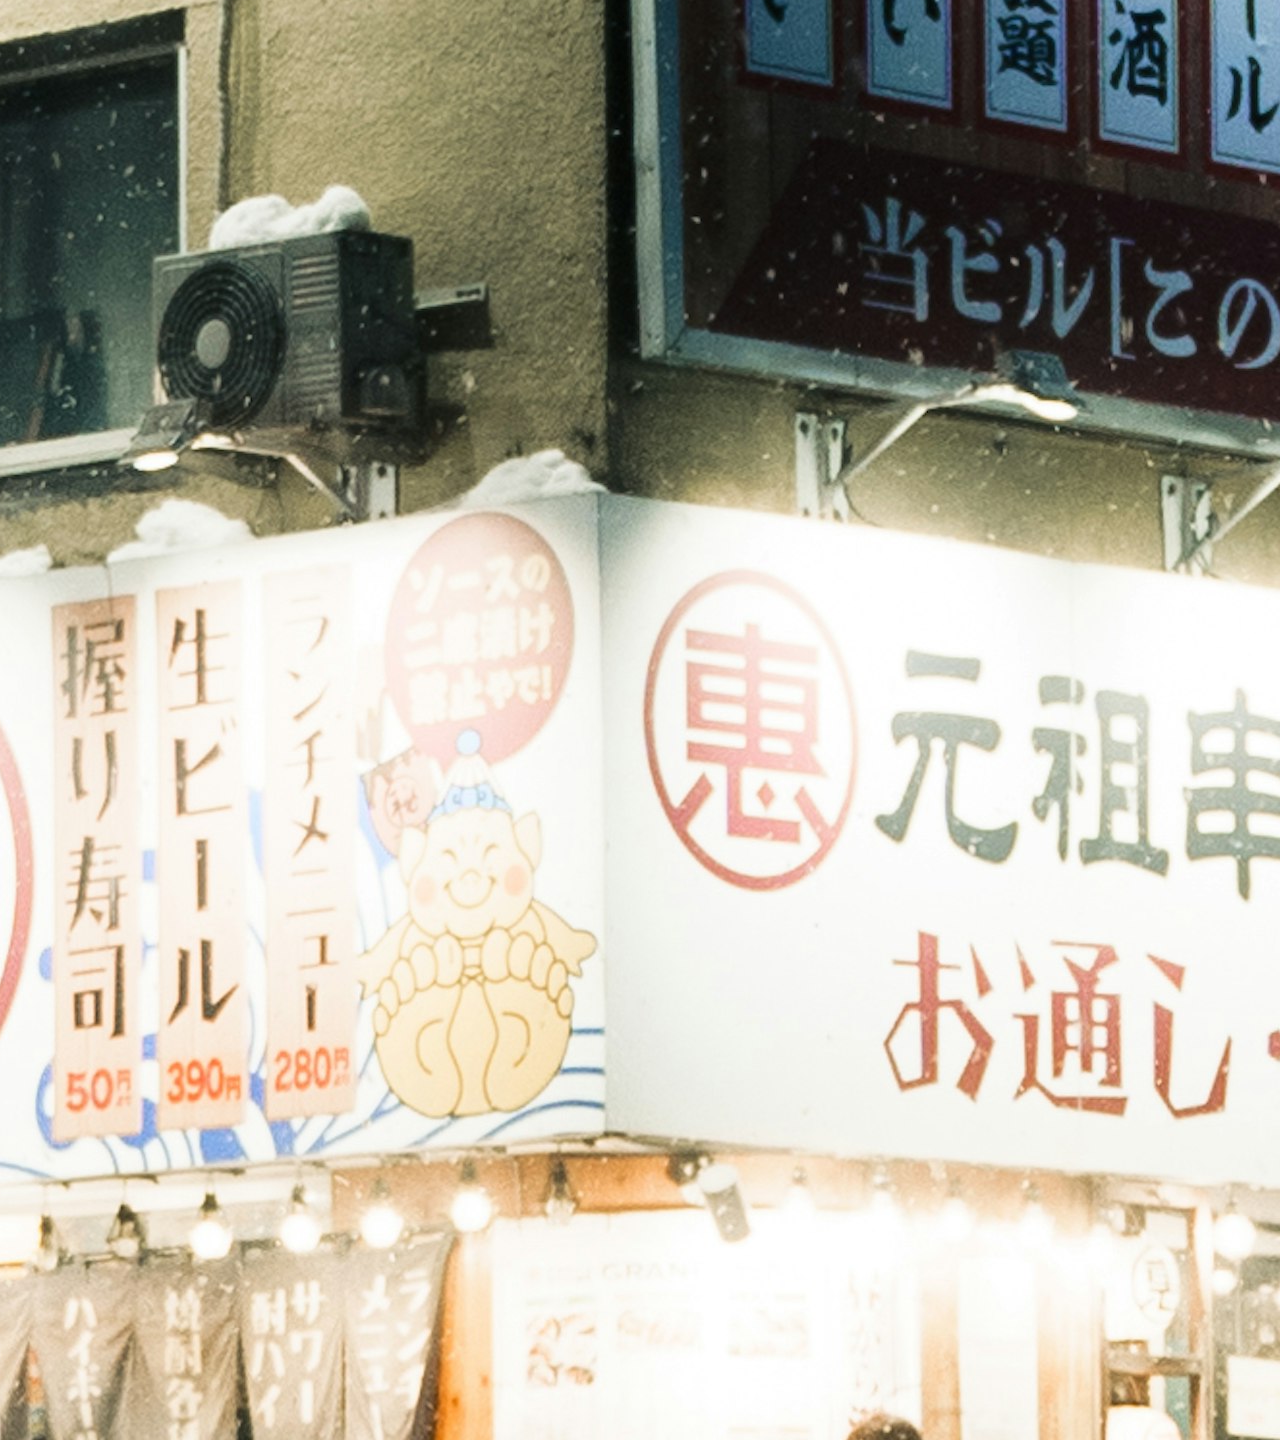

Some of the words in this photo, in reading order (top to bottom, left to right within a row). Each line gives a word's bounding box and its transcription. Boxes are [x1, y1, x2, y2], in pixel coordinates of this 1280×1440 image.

[60, 617, 127, 1039] 握り寿司
[166, 606, 239, 1027] 生ビール
[285, 596, 337, 1033] ランチメニュー
[403, 601, 556, 671] 二け
[408, 663, 552, 726] 止やで!
